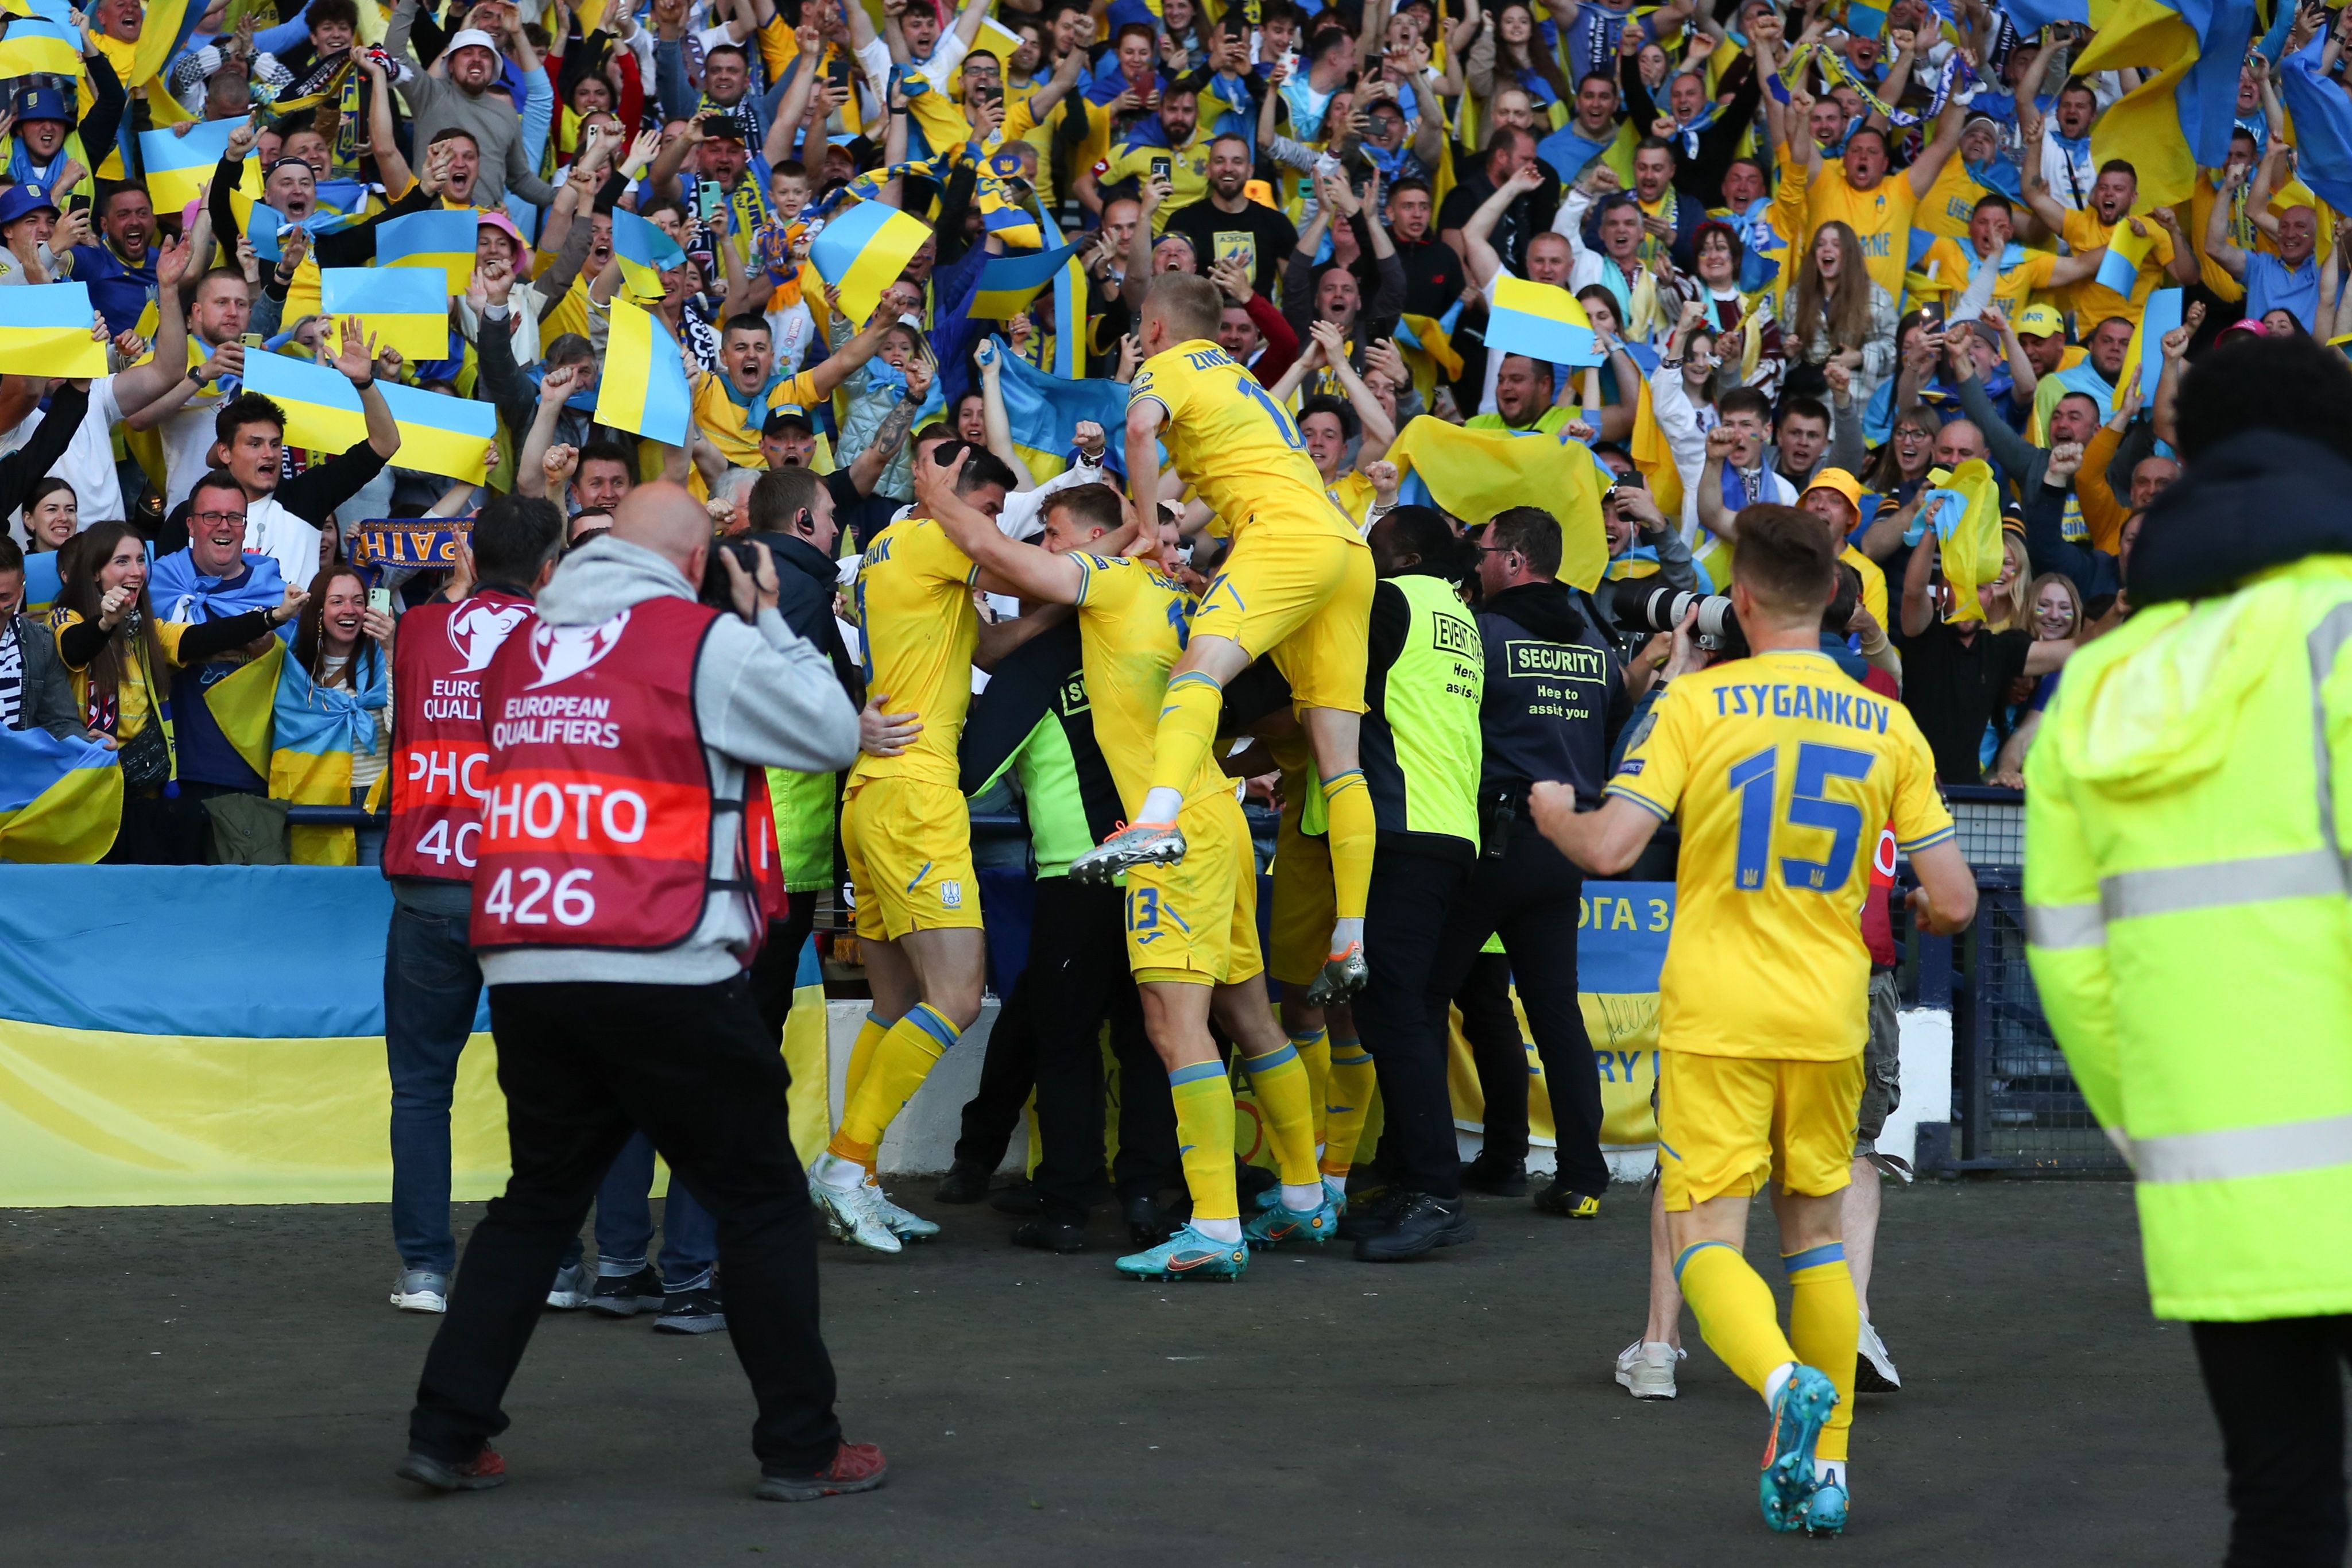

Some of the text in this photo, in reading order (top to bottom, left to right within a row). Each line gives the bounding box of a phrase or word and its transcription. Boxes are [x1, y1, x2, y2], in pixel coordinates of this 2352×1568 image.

[1440, 618, 1470, 653] EVENT
[1518, 648, 1598, 673] SECURITY
[505, 696, 610, 719] EUROPEAN
[1537, 685, 1579, 700] Hee to
[1713, 685, 1888, 734] TSYGANKOV
[1529, 703, 1589, 720] assit you
[493, 719, 620, 752] QUALIFIERS
[1728, 741, 1877, 895] 15
[485, 867, 595, 926] 426
[1127, 888, 1158, 931] 13
